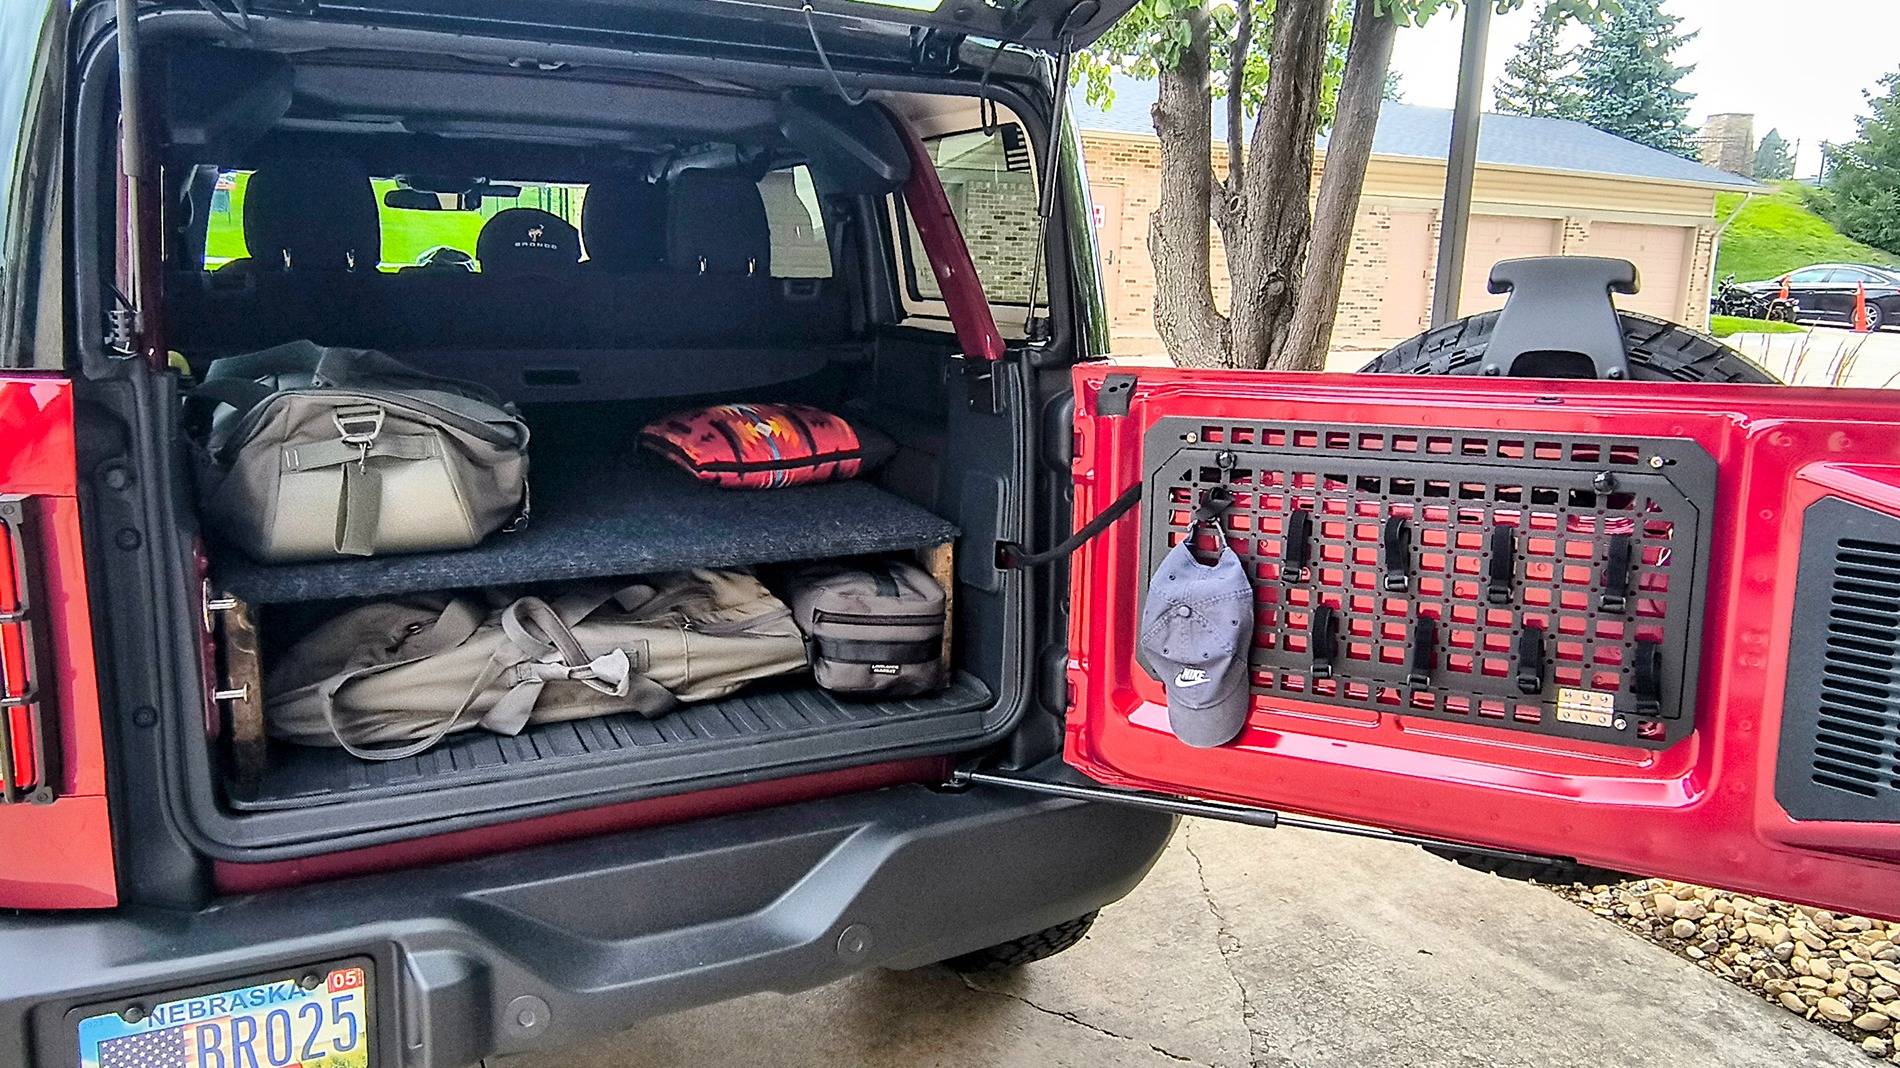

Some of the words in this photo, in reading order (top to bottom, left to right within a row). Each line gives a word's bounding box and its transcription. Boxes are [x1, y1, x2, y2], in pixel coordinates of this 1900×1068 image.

[514, 241, 557, 250] BRONCO
[1181, 667, 1206, 680] NIKE
[333, 970, 357, 988] 05
[148, 983, 307, 1028] NEBRASKA
